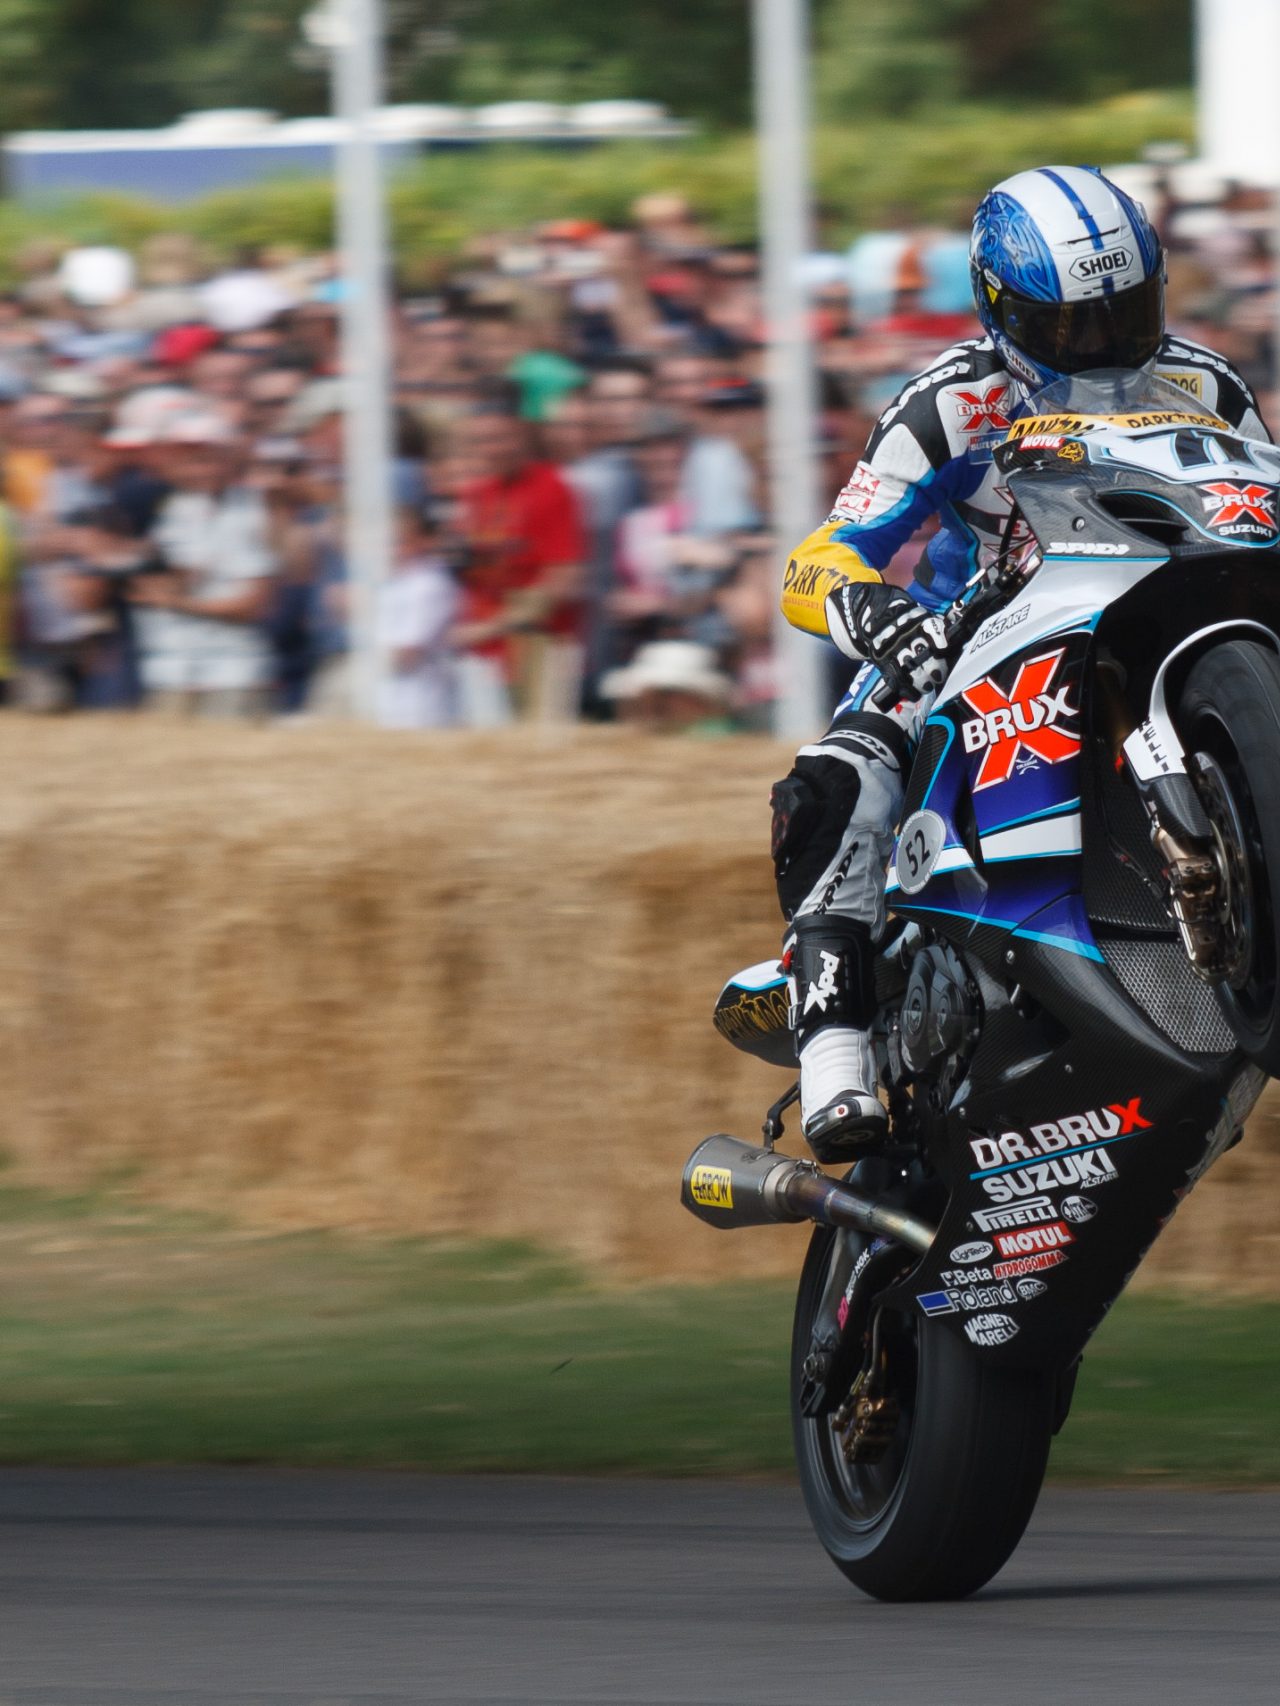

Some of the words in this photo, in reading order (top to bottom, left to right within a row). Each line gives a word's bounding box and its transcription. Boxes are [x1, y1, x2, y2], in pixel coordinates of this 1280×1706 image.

[1079, 251, 1127, 277] SHOEI
[1020, 435, 1062, 449] MOTUL
[1202, 494, 1275, 514] BRUX
[1218, 524, 1272, 538] SUZUKI
[962, 685, 1079, 754] BRUX
[905, 829, 931, 878] 52
[982, 1148, 1117, 1203] SUZUKI
[971, 1196, 1059, 1233] PIRELLI
[998, 1225, 1071, 1256] MOTUL
[952, 1267, 993, 1286] Beta
[945, 1279, 1018, 1312] Roland
